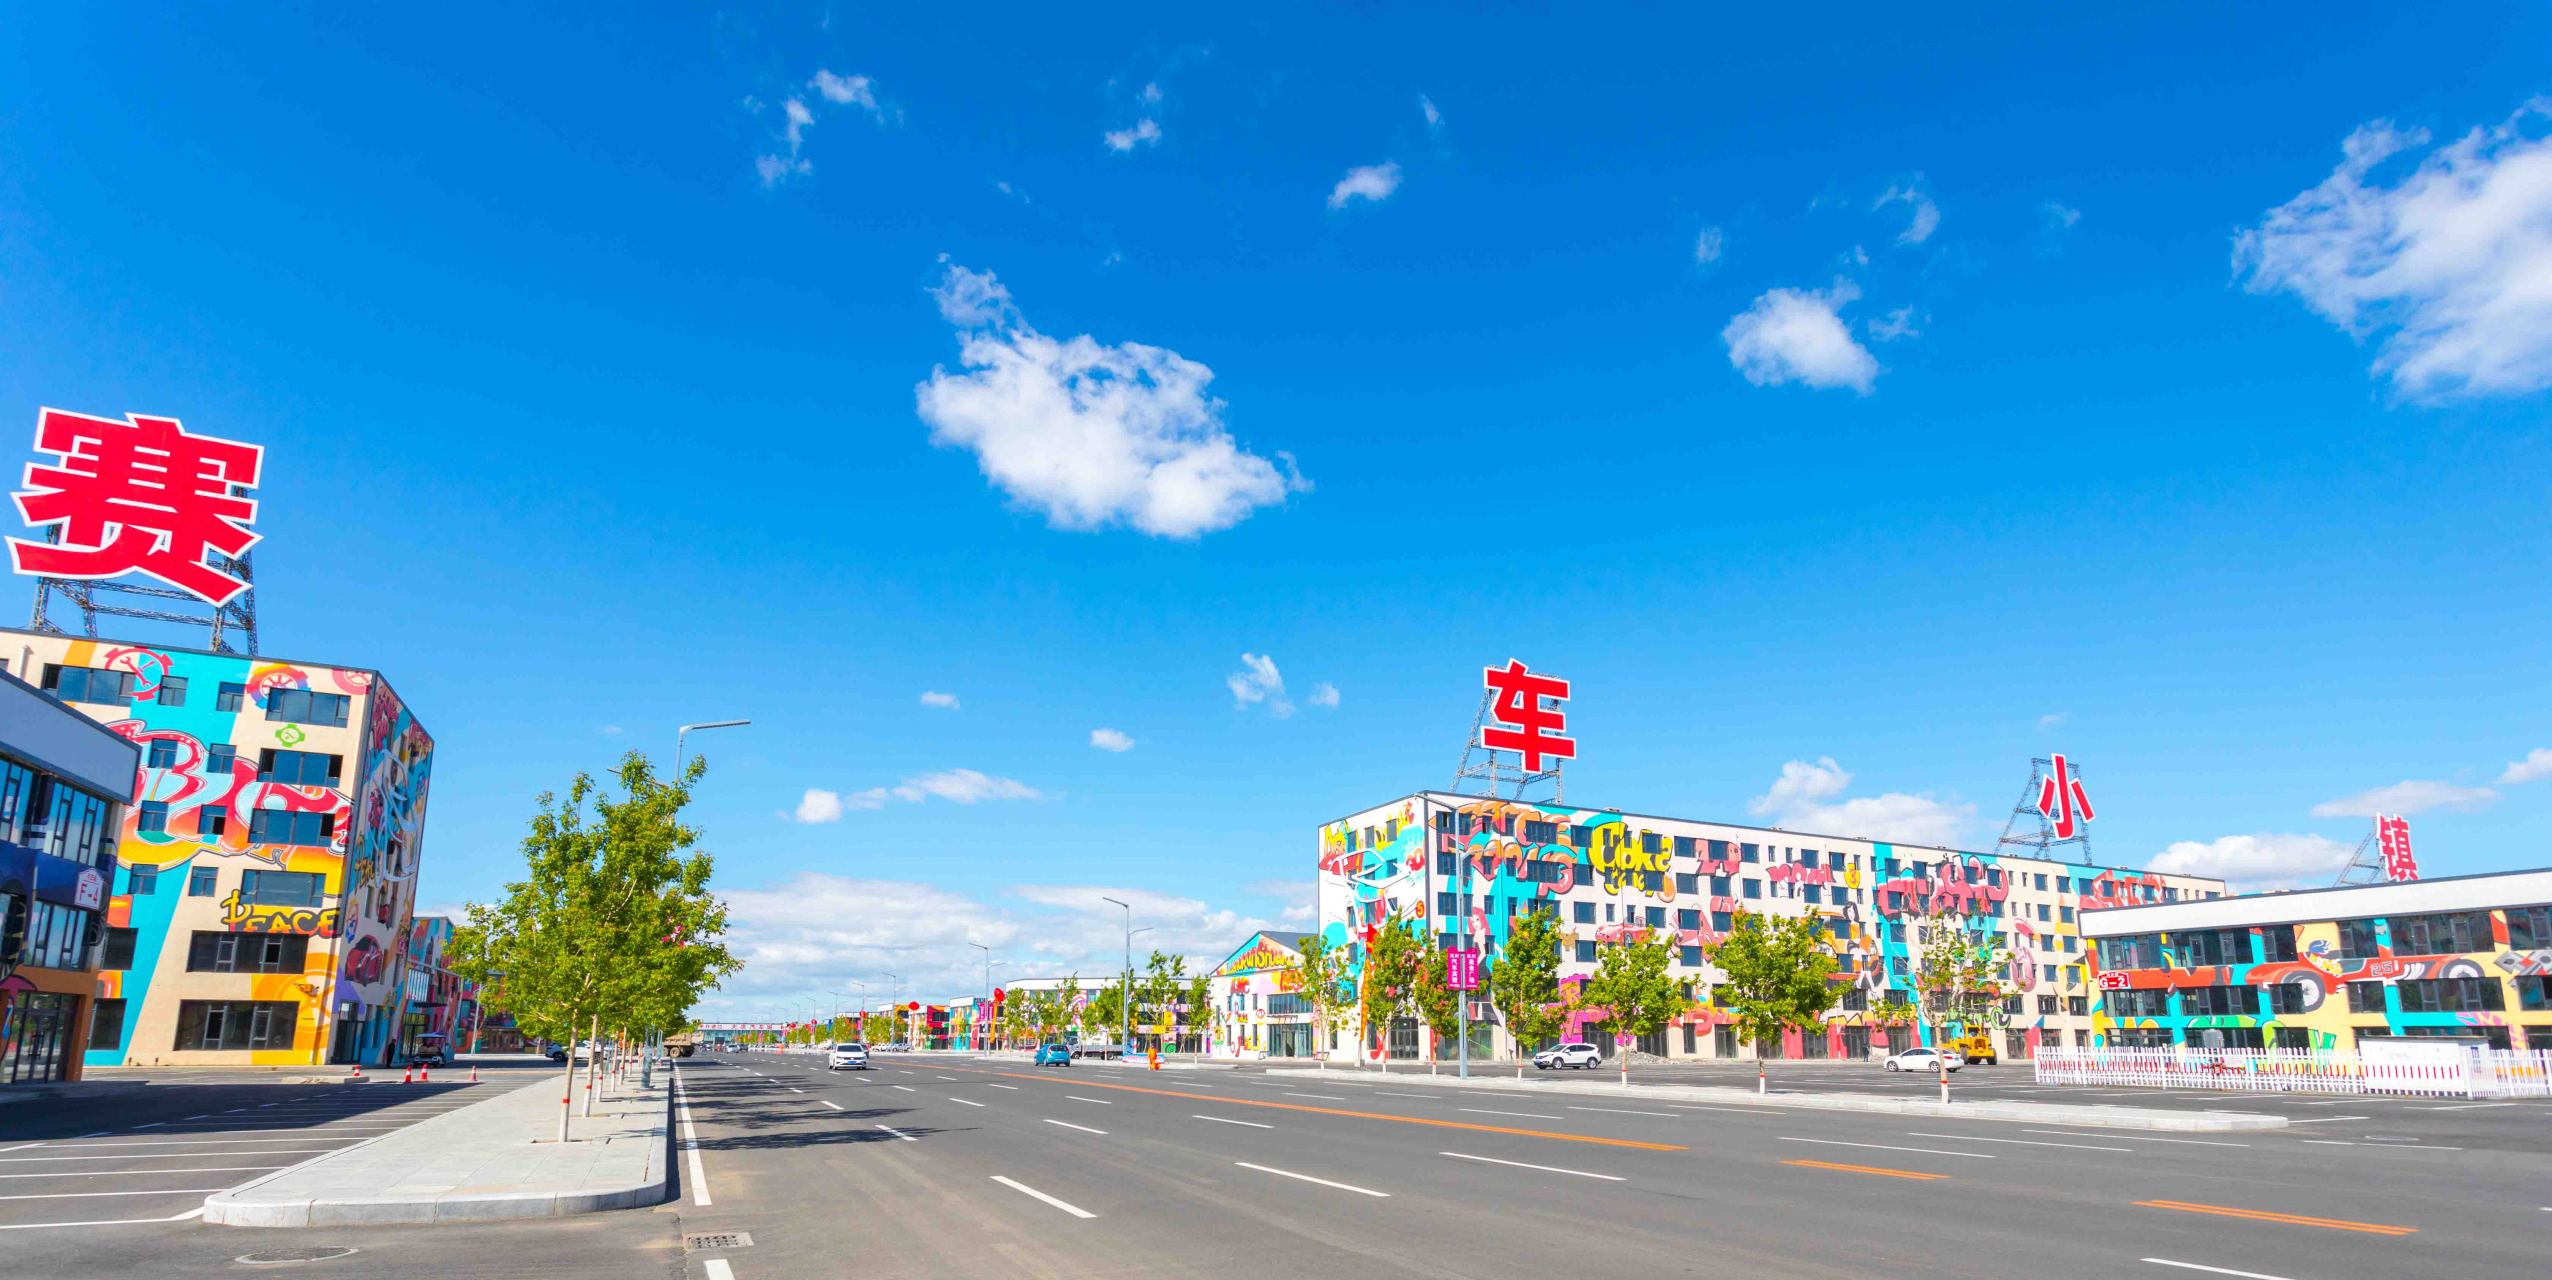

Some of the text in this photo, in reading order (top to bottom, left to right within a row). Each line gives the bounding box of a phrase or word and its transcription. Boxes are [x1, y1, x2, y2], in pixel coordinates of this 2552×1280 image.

[5, 406, 264, 608] 赛
[1480, 657, 1576, 774] 车
[2036, 753, 2096, 840] 小
[2376, 813, 2419, 881] 镇
[221, 888, 343, 938] PEACE
[2099, 977, 2126, 988] G-2
